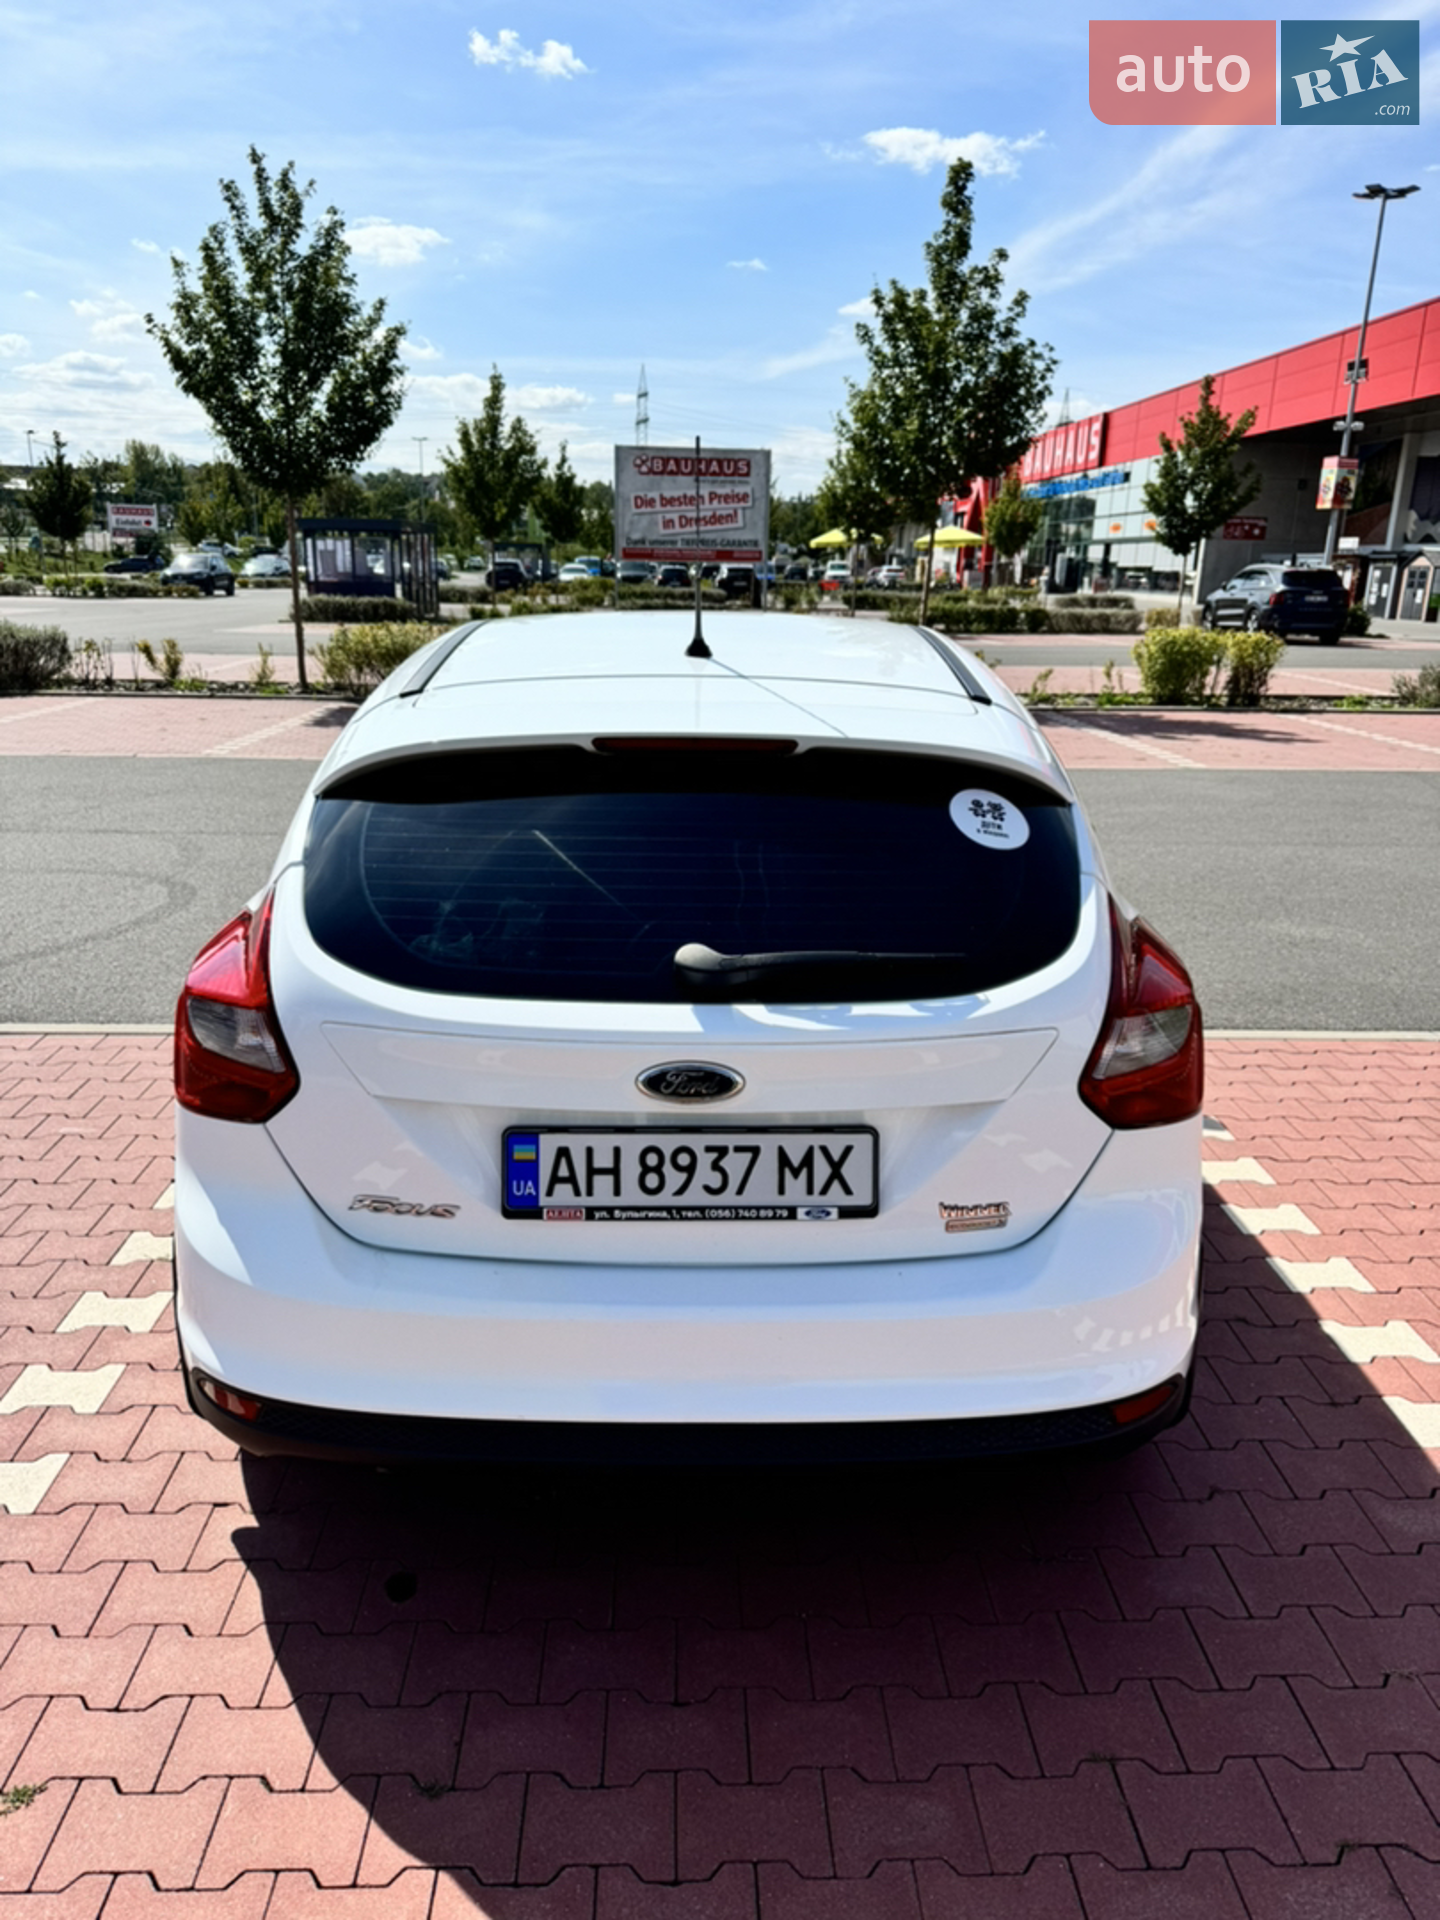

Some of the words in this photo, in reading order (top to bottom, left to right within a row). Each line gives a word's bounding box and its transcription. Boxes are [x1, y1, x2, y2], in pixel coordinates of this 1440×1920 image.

[1023, 421, 1101, 477] BAUHAUS
[652, 458, 749, 475] BAUHAUS
[634, 494, 657, 509] Die
[659, 492, 705, 507] besten
[708, 489, 750, 505] Preise
[662, 516, 675, 530] in
[679, 508, 739, 529] Dresden!
[660, 1070, 720, 1095] Ford
[545, 1145, 621, 1197] AH
[638, 1145, 761, 1196] 8937
[777, 1144, 854, 1196] MX
[513, 1180, 537, 1196] UA
[705, 1208, 736, 1219] (056)
